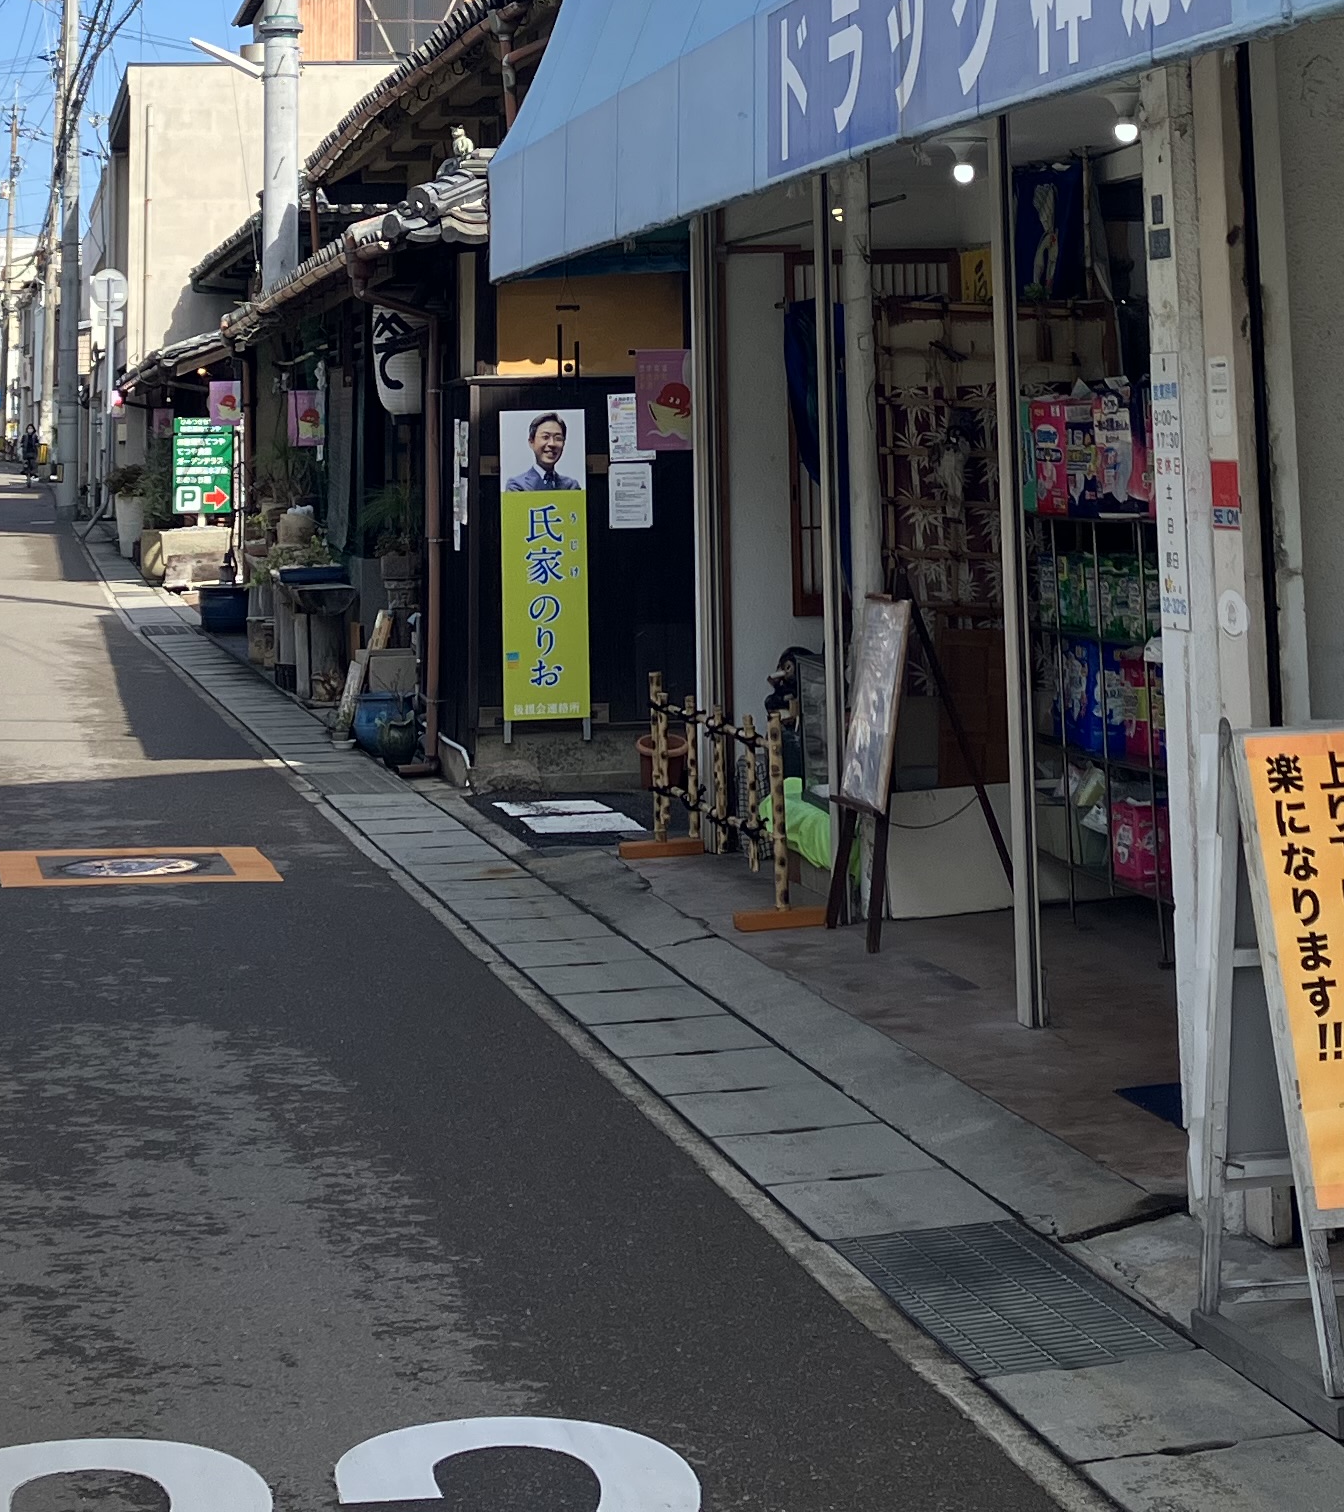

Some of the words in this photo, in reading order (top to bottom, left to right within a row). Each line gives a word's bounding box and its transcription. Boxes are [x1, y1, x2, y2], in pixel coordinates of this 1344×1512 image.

[1156, 431, 1180, 450] 17:30
[1156, 457, 1181, 476] 定休日
[569, 512, 580, 577] うじけ
[525, 505, 563, 686] 氏家のりお
[1265, 753, 1344, 1061] 楽になります!!
